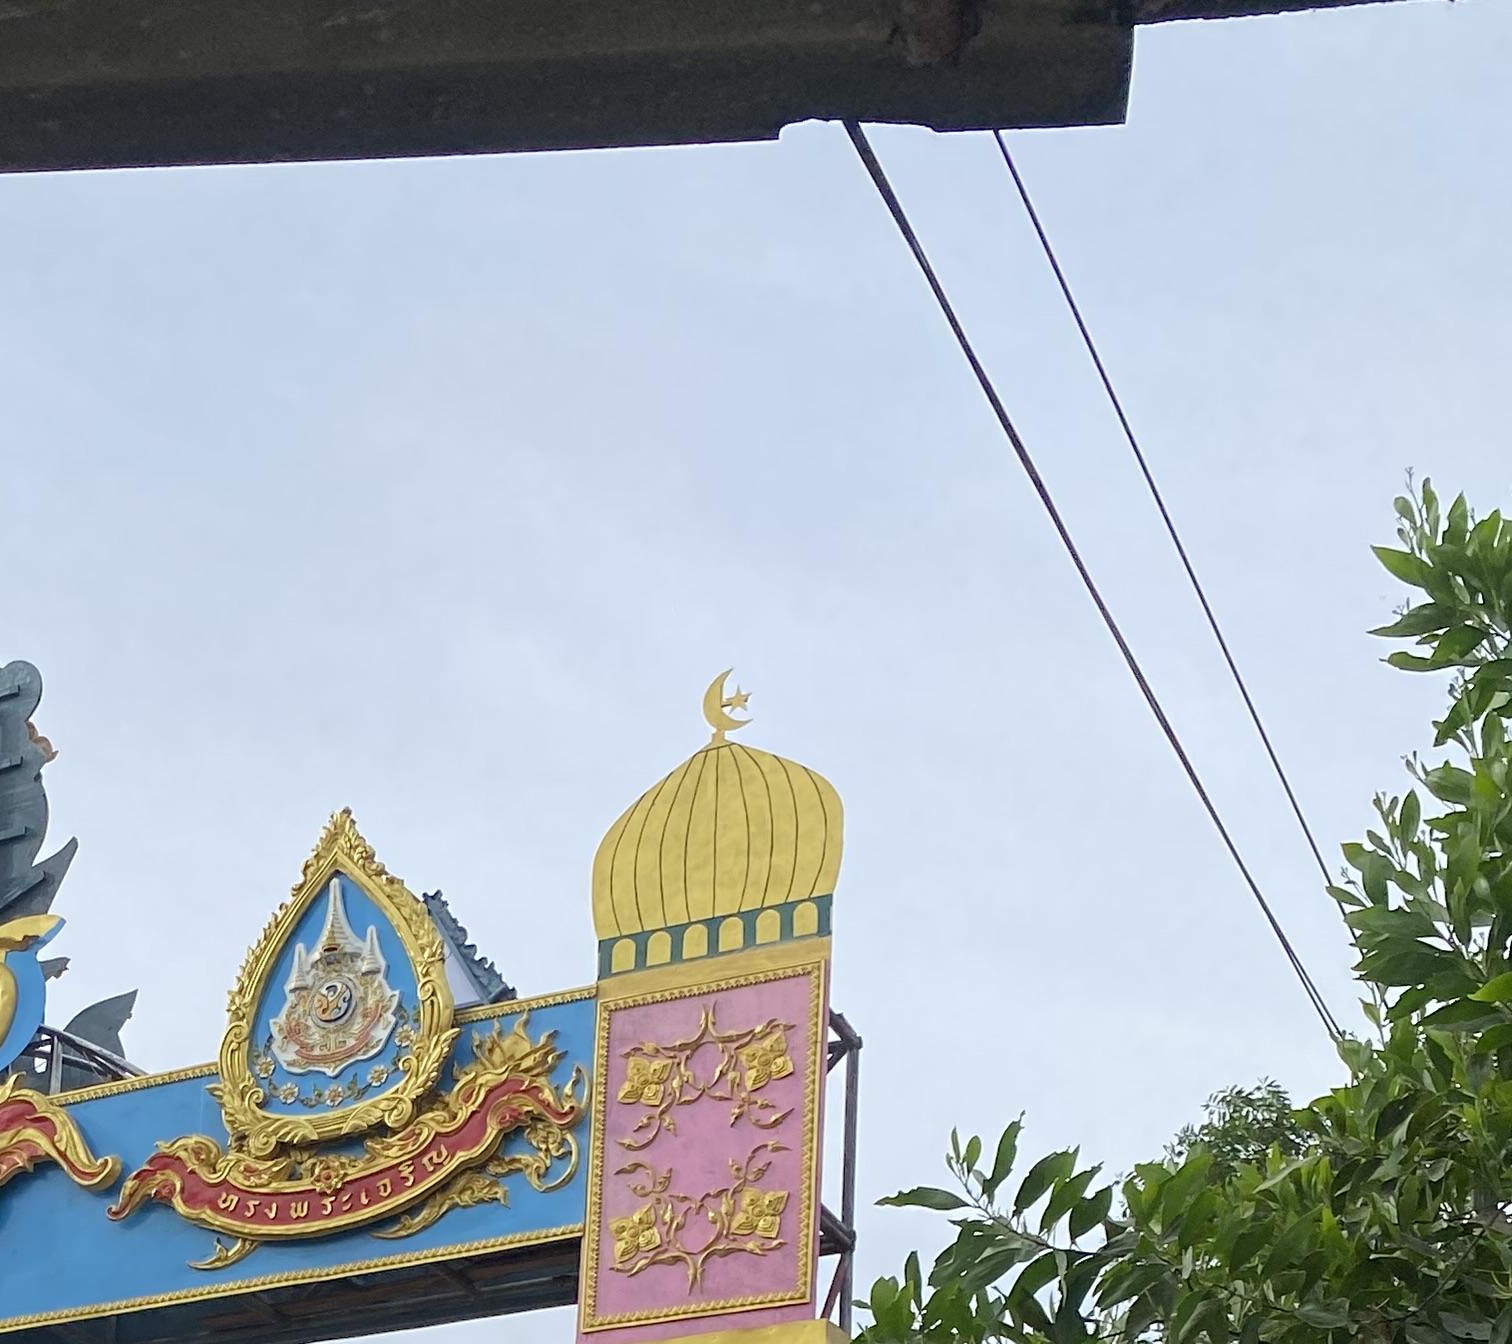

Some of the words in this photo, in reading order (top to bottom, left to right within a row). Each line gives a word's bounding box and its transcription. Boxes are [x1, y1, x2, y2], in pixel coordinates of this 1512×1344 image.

[217, 1144, 449, 1219] ทรงพระเจริญ
